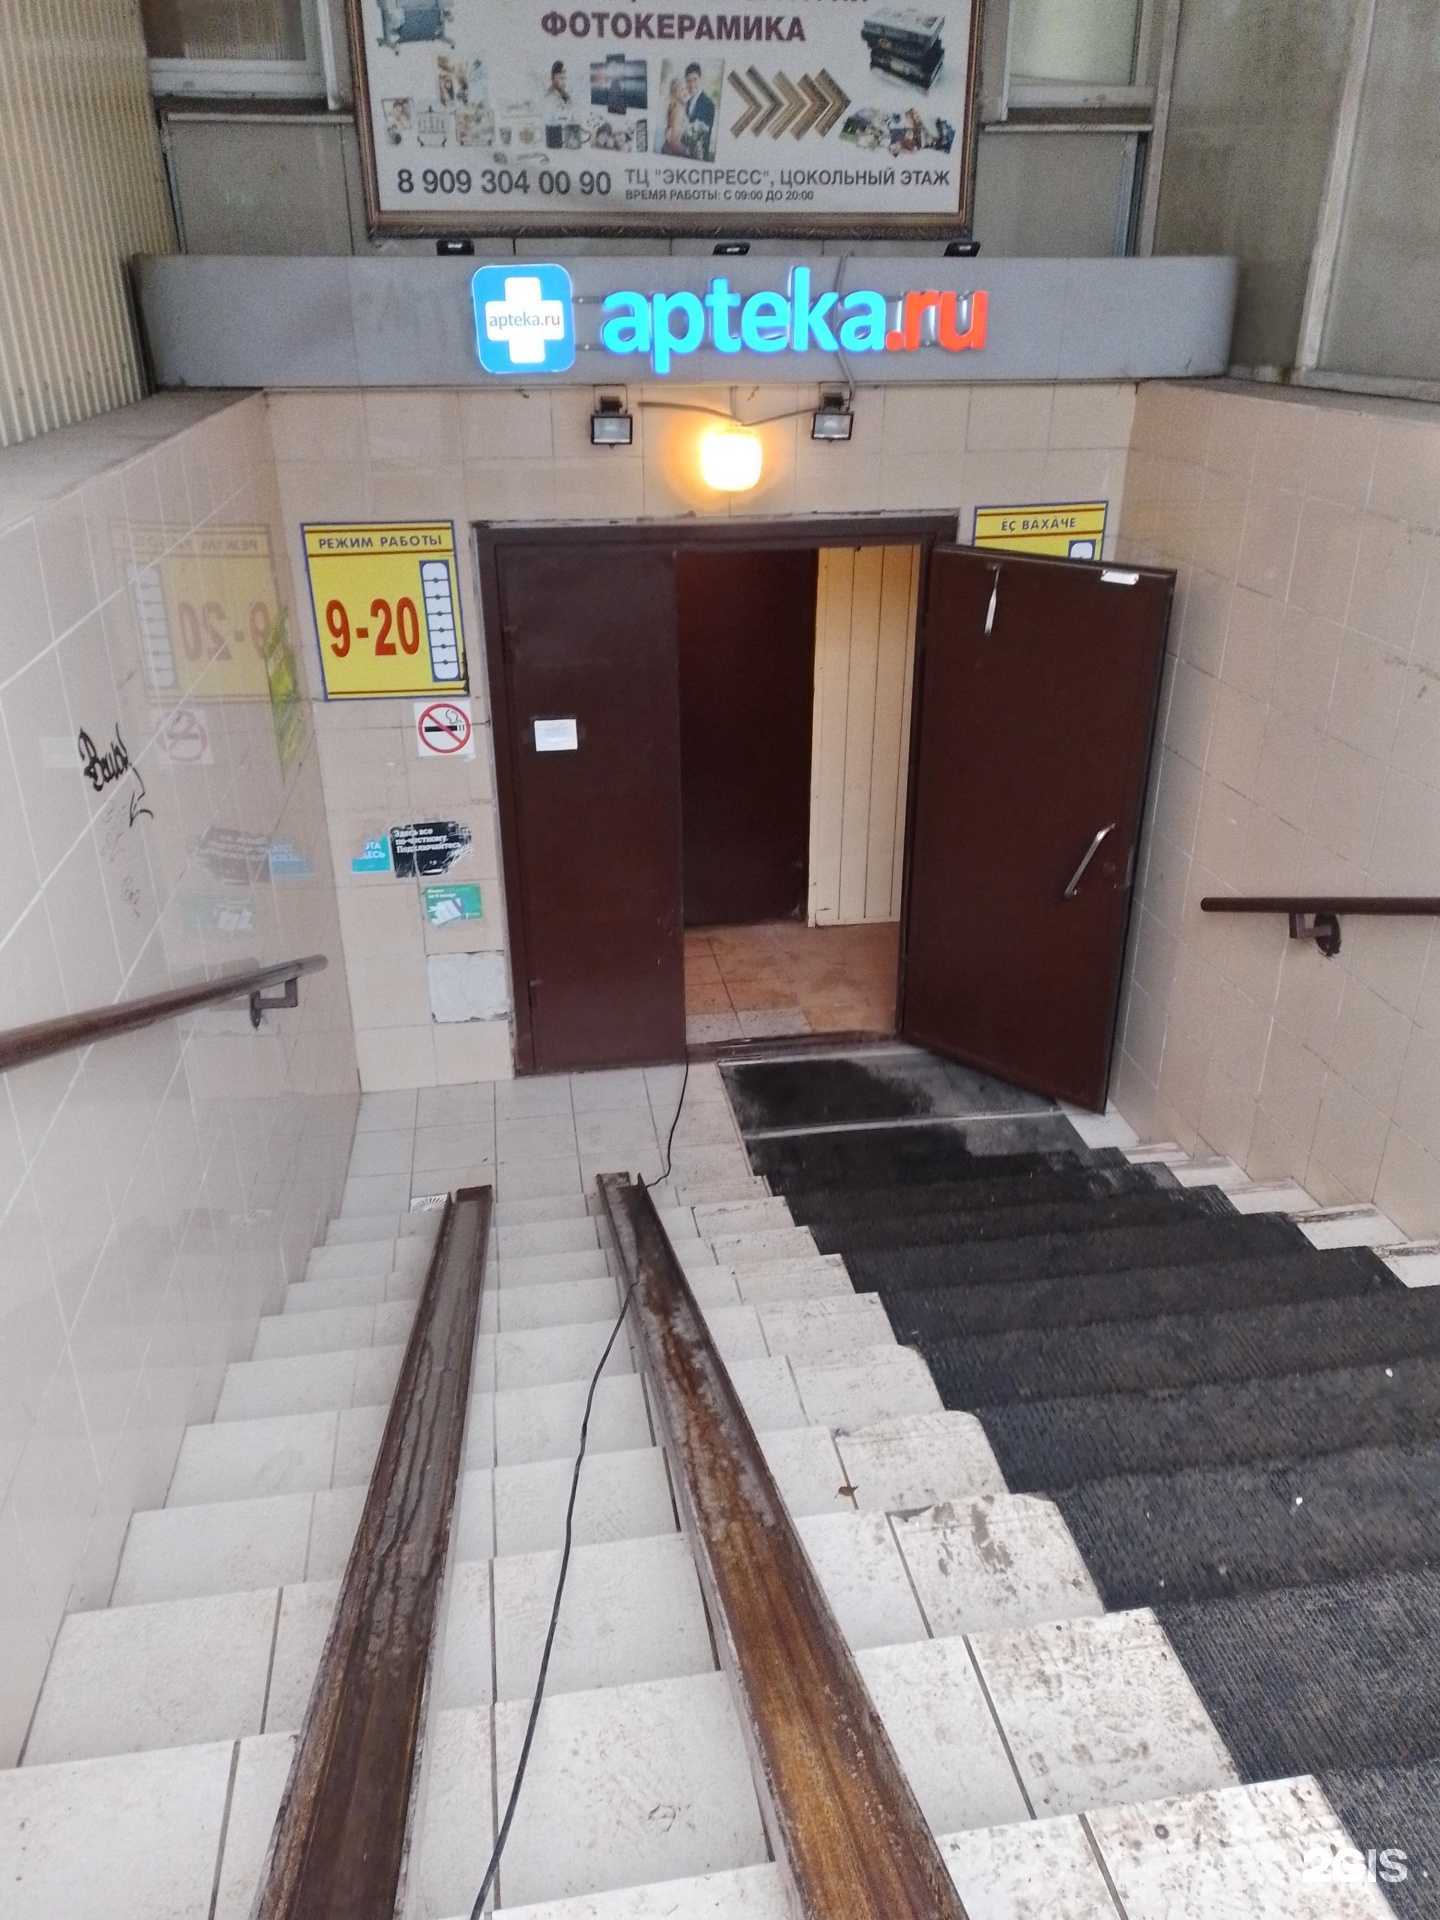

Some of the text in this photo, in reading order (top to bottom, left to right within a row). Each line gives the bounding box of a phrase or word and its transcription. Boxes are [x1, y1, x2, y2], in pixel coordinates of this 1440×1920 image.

[541, 11, 806, 42] ФОТОКЕРАМИКА
[397, 169, 611, 195] 8 909 304 00 90
[625, 168, 951, 188] ТЦ "ЭКСПРЕСС", ЦОКОЛЬНЫЙ ЭТАЖ
[626, 190, 814, 202] ВРЕМЯ РАБОТЫ: С 09:00 ДО 20:00
[489, 312, 561, 330] apteka.ru
[602, 266, 988, 375] apteka.ru
[319, 535, 442, 549] РЕЖИМ РАБОТЫ
[325, 597, 420, 658] 9-20
